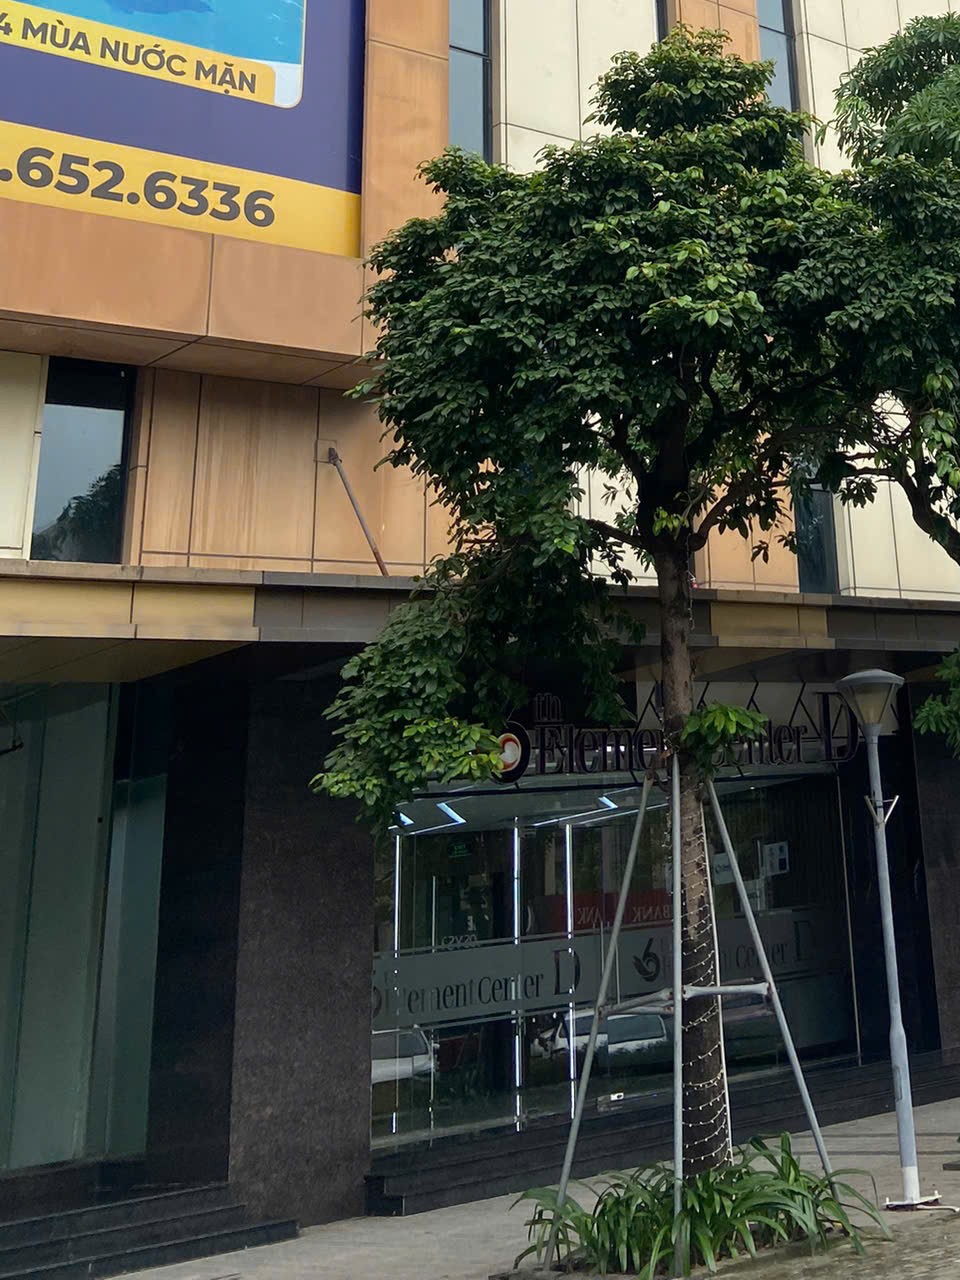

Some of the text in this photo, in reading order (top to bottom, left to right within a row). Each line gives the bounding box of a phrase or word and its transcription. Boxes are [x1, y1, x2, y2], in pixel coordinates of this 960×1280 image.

[21, 18, 92, 56] MÙA
[100, 37, 187, 77] NƯỚC
[195, 60, 257, 95] MẶN
